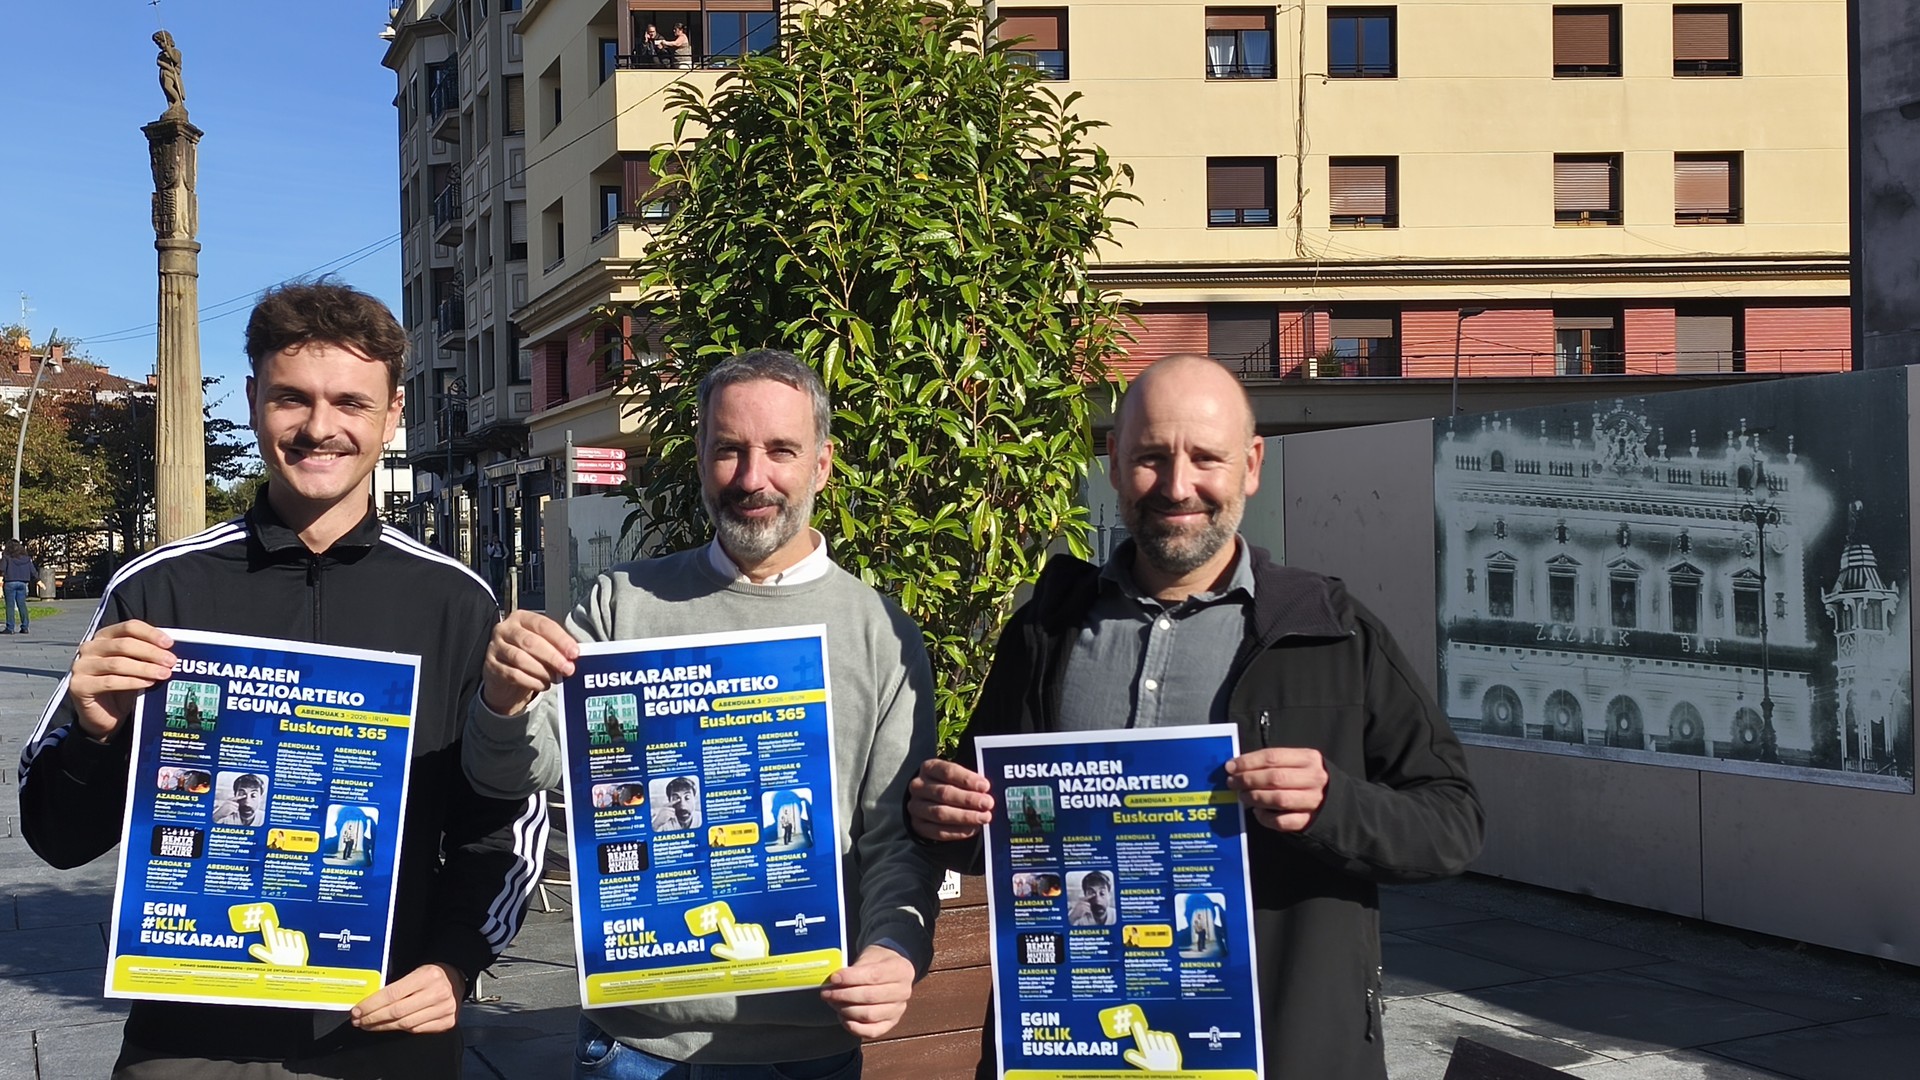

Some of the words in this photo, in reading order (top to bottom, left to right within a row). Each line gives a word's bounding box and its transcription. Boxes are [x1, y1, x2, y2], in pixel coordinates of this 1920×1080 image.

[174, 660, 300, 684] EUSKARAREN
[585, 664, 711, 689] EUSKARAREN
[228, 681, 365, 706] NAZIOARTEKO
[644, 675, 779, 700] NAZIOARTEKO
[227, 696, 293, 715] EGUNA
[645, 697, 710, 717] EGUNA
[700, 709, 773, 728] Euskarak
[776, 707, 806, 722] 365
[279, 719, 355, 737] Euskarak
[357, 727, 387, 742] 365
[757, 731, 793, 740] ABENDUAK
[278, 742, 315, 750] ABENDUAK
[646, 742, 679, 751] AZAROAK
[702, 737, 738, 745] ABENDUAK
[759, 763, 795, 772] ABENDUAK
[1003, 760, 1123, 779] EUSKARAREN
[1059, 774, 1189, 793] NAZIOARTEKO
[706, 790, 742, 798] ABENDUAK
[1060, 793, 1122, 809] EGUNA
[594, 809, 627, 818] AZAROAK
[1112, 809, 1185, 823] Euskarak
[1188, 808, 1217, 822] 365
[653, 833, 685, 842] AZAROAK
[710, 848, 746, 857] ABENDUAK
[766, 853, 801, 862] ABENDUAK
[599, 876, 632, 885] AZAROAK
[656, 870, 692, 879] ABENDUAK
[143, 902, 187, 917] EGIN
[1014, 900, 1045, 908] AZAROAK
[141, 916, 198, 932] #KLIK
[603, 917, 645, 935] EGIN
[140, 931, 244, 949] EUSKARARI
[604, 930, 657, 949] #KLIK
[606, 939, 705, 962] EUSKARARI
[1021, 1012, 1060, 1029] EGIN
[1022, 1027, 1072, 1041] #KLIK
[1023, 1042, 1118, 1056] EUSKARARI
